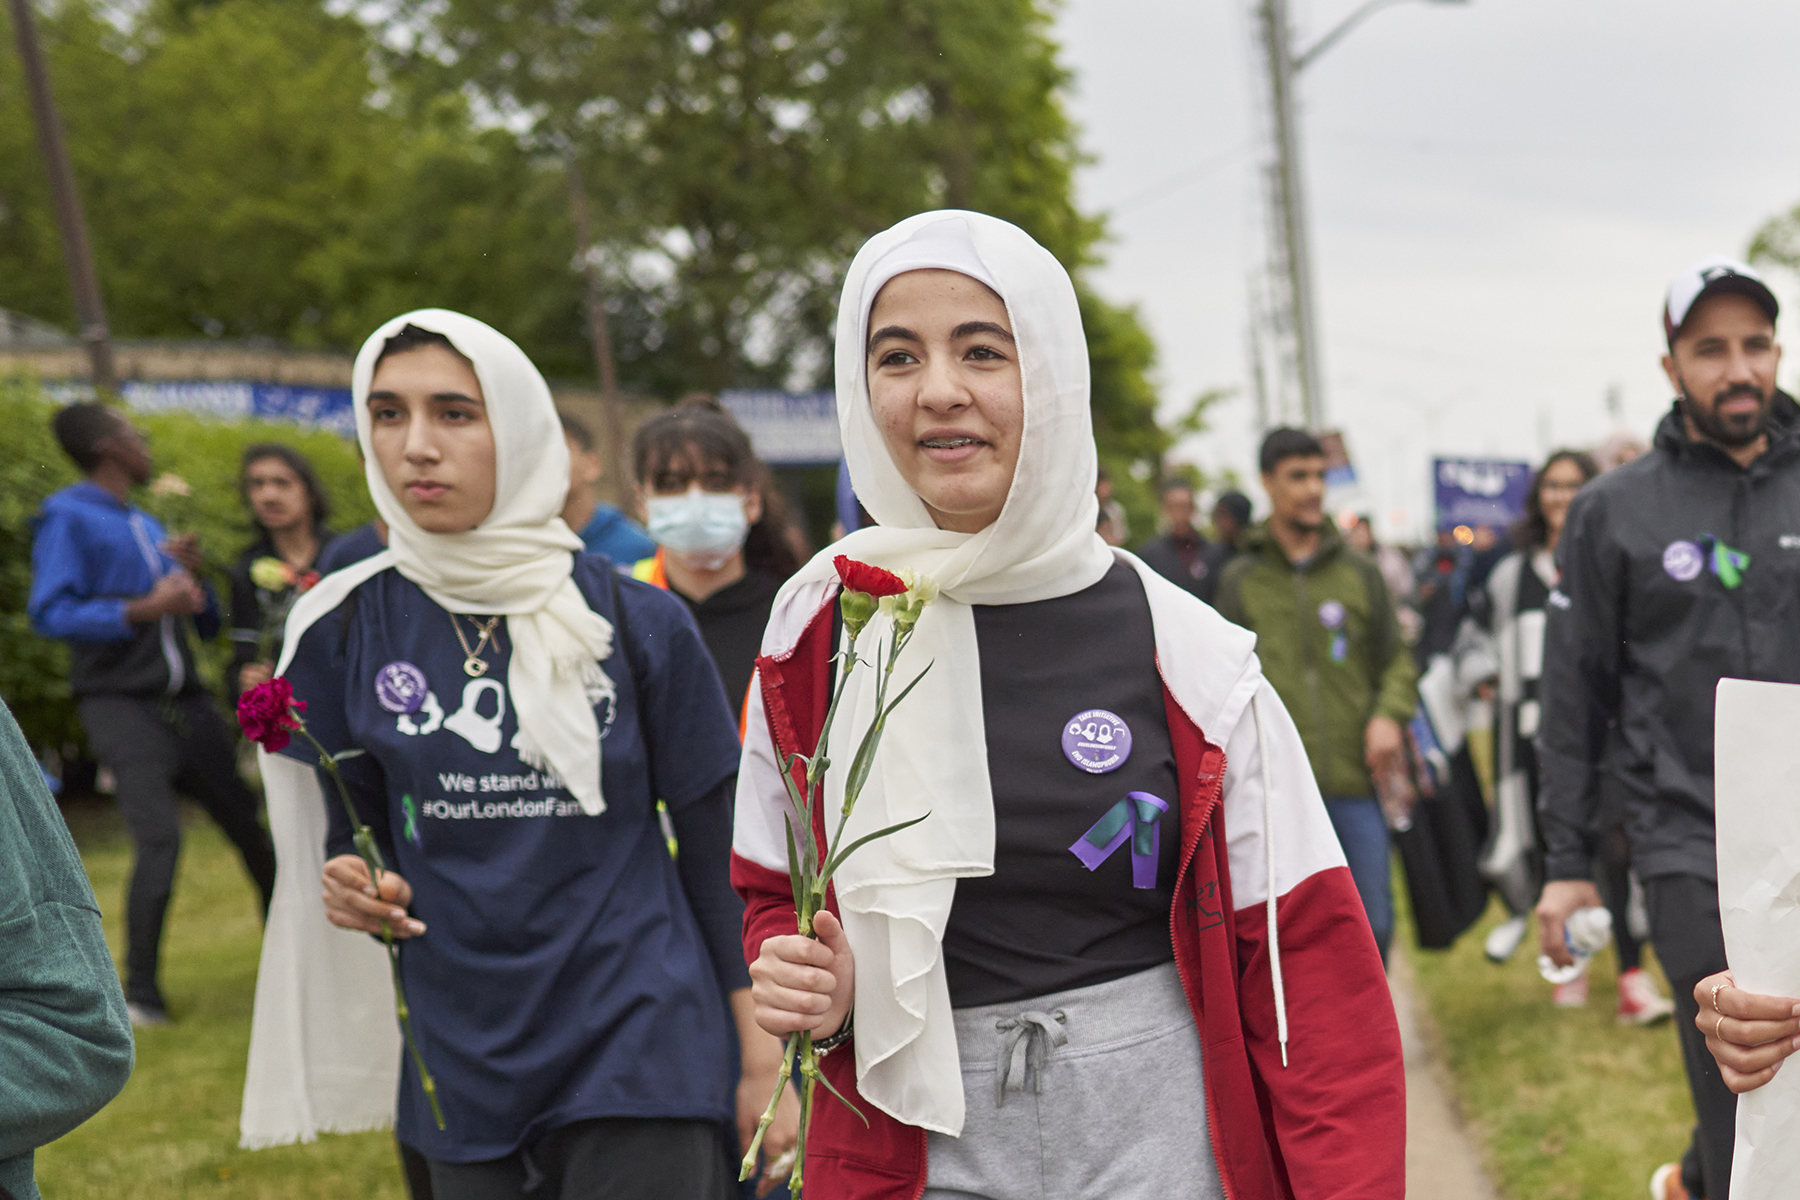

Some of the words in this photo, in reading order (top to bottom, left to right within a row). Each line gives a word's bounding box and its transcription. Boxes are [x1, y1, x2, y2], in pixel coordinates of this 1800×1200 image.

[1092, 711, 1120, 726] INITIATIVE
[1071, 750, 1083, 761] END
[438, 773, 477, 792] We
[479, 770, 539, 791] stand
